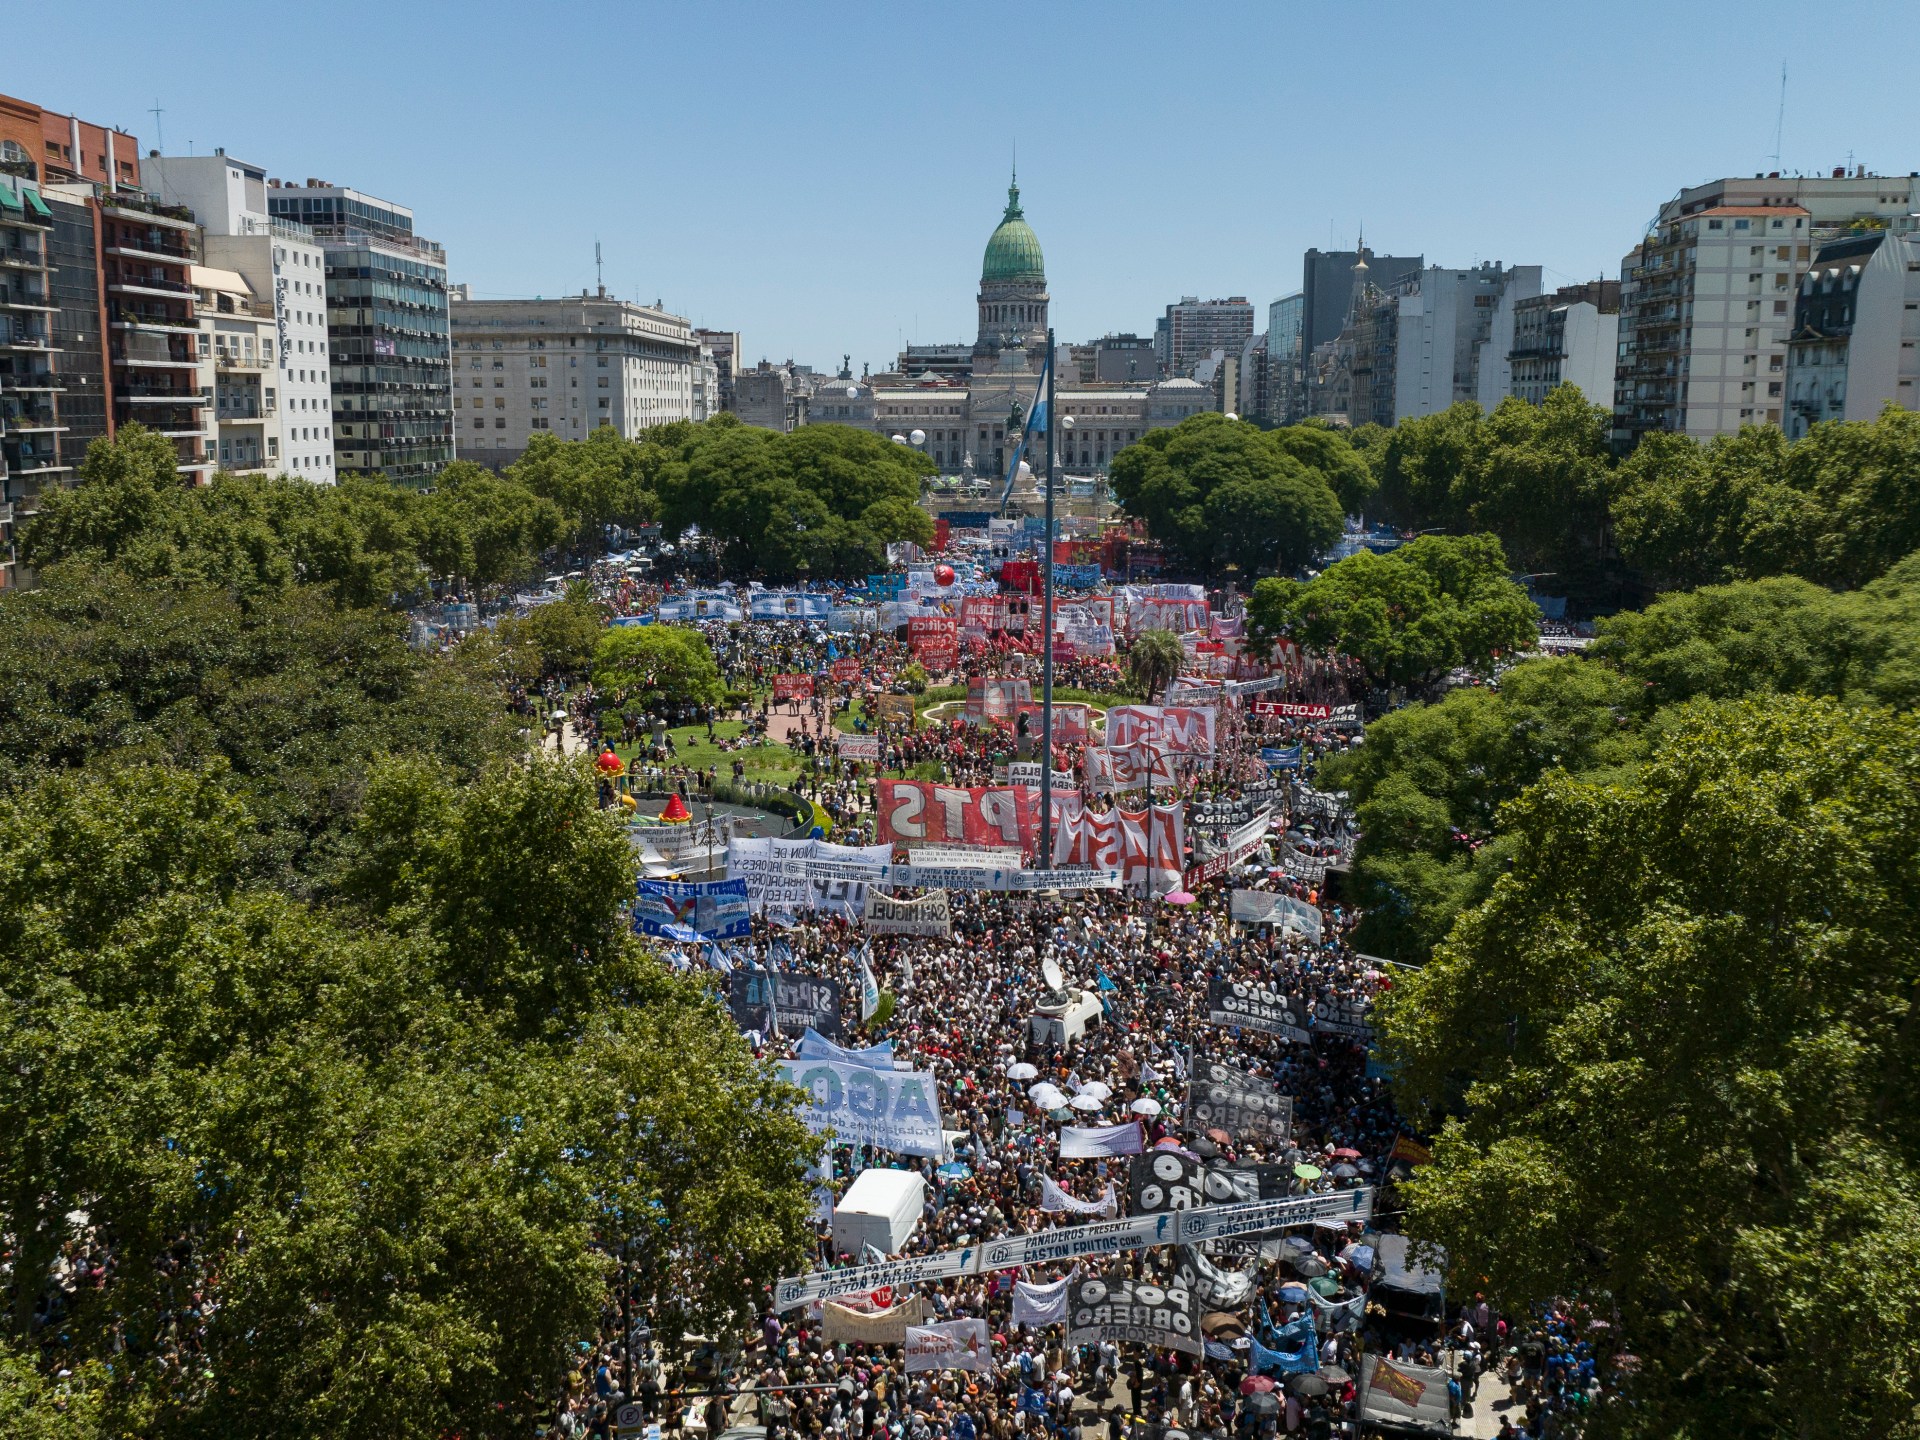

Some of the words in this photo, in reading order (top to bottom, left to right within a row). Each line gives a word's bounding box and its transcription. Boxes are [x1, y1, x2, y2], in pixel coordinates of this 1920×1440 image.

[1256, 701, 1275, 714] LA
[1282, 703, 1327, 718] RIOJA
[805, 861, 839, 872] PANADEROS
[970, 869, 987, 877] VENDE
[1187, 868, 1200, 889] LA
[1203, 852, 1228, 881] RIOJA
[805, 869, 830, 881] GASTON
[832, 871, 859, 882] FRUTOS
[915, 879, 945, 887] GASTON
[946, 879, 973, 888] FRUTOS
[1217, 1207, 1228, 1217] LA
[1227, 1207, 1317, 1224] PANADEROS
[1217, 1219, 1264, 1237] GASTON
[1269, 1213, 1314, 1228] FRUTOS
[1025, 1228, 1085, 1248] PANADEROS
[1088, 1221, 1132, 1235] PRESENTE
[1023, 1244, 1069, 1263] GASTON
[1073, 1236, 1118, 1254] FRUTOS
[838, 1267, 855, 1277] UN
[861, 1261, 895, 1273] PASO
[901, 1254, 941, 1266] ATRAS
[816, 1279, 865, 1297] GASTON
[869, 1272, 917, 1286] FRUTOS
